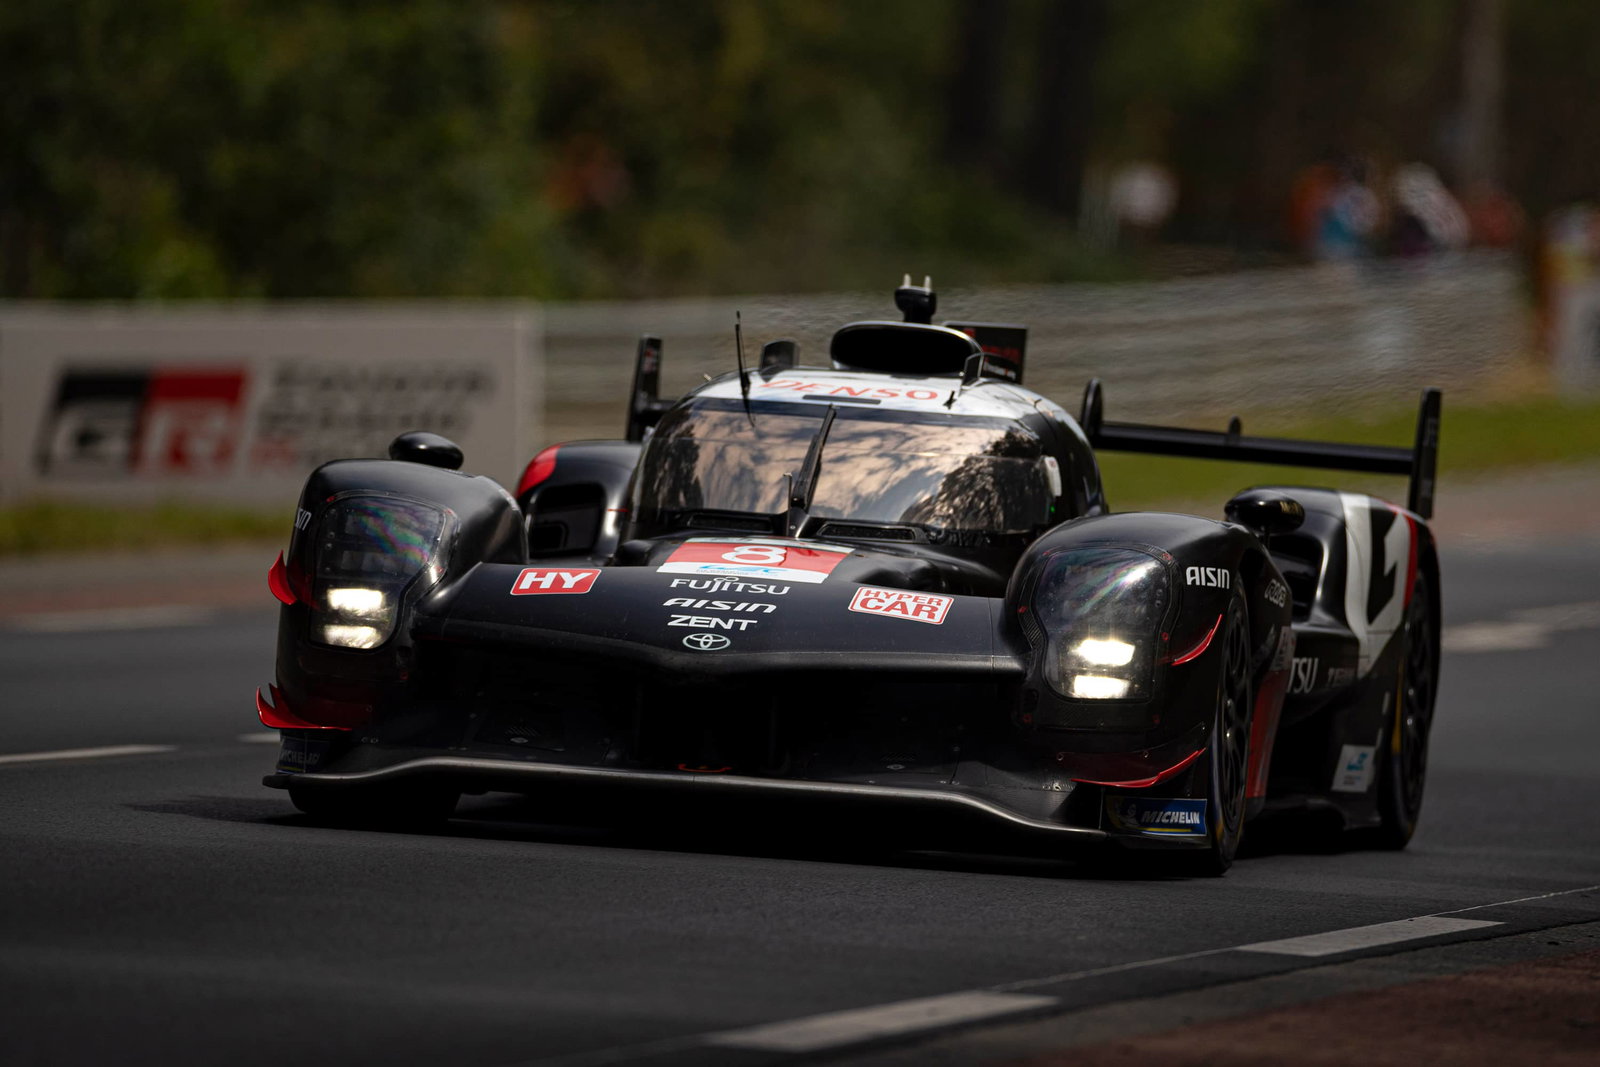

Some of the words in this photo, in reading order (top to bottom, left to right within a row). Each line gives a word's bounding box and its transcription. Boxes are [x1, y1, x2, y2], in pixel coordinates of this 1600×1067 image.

[760, 380, 938, 400] DENSO
[721, 545, 787, 564] 8
[518, 571, 589, 589] HY
[669, 577, 791, 595] FUJITSU
[1186, 565, 1231, 590] AISIN
[662, 598, 778, 614] AISIN
[864, 589, 944, 606] HYPER
[860, 597, 939, 619] CAR
[667, 614, 758, 631] ZENT
[1140, 810, 1200, 825] MICHELIN
